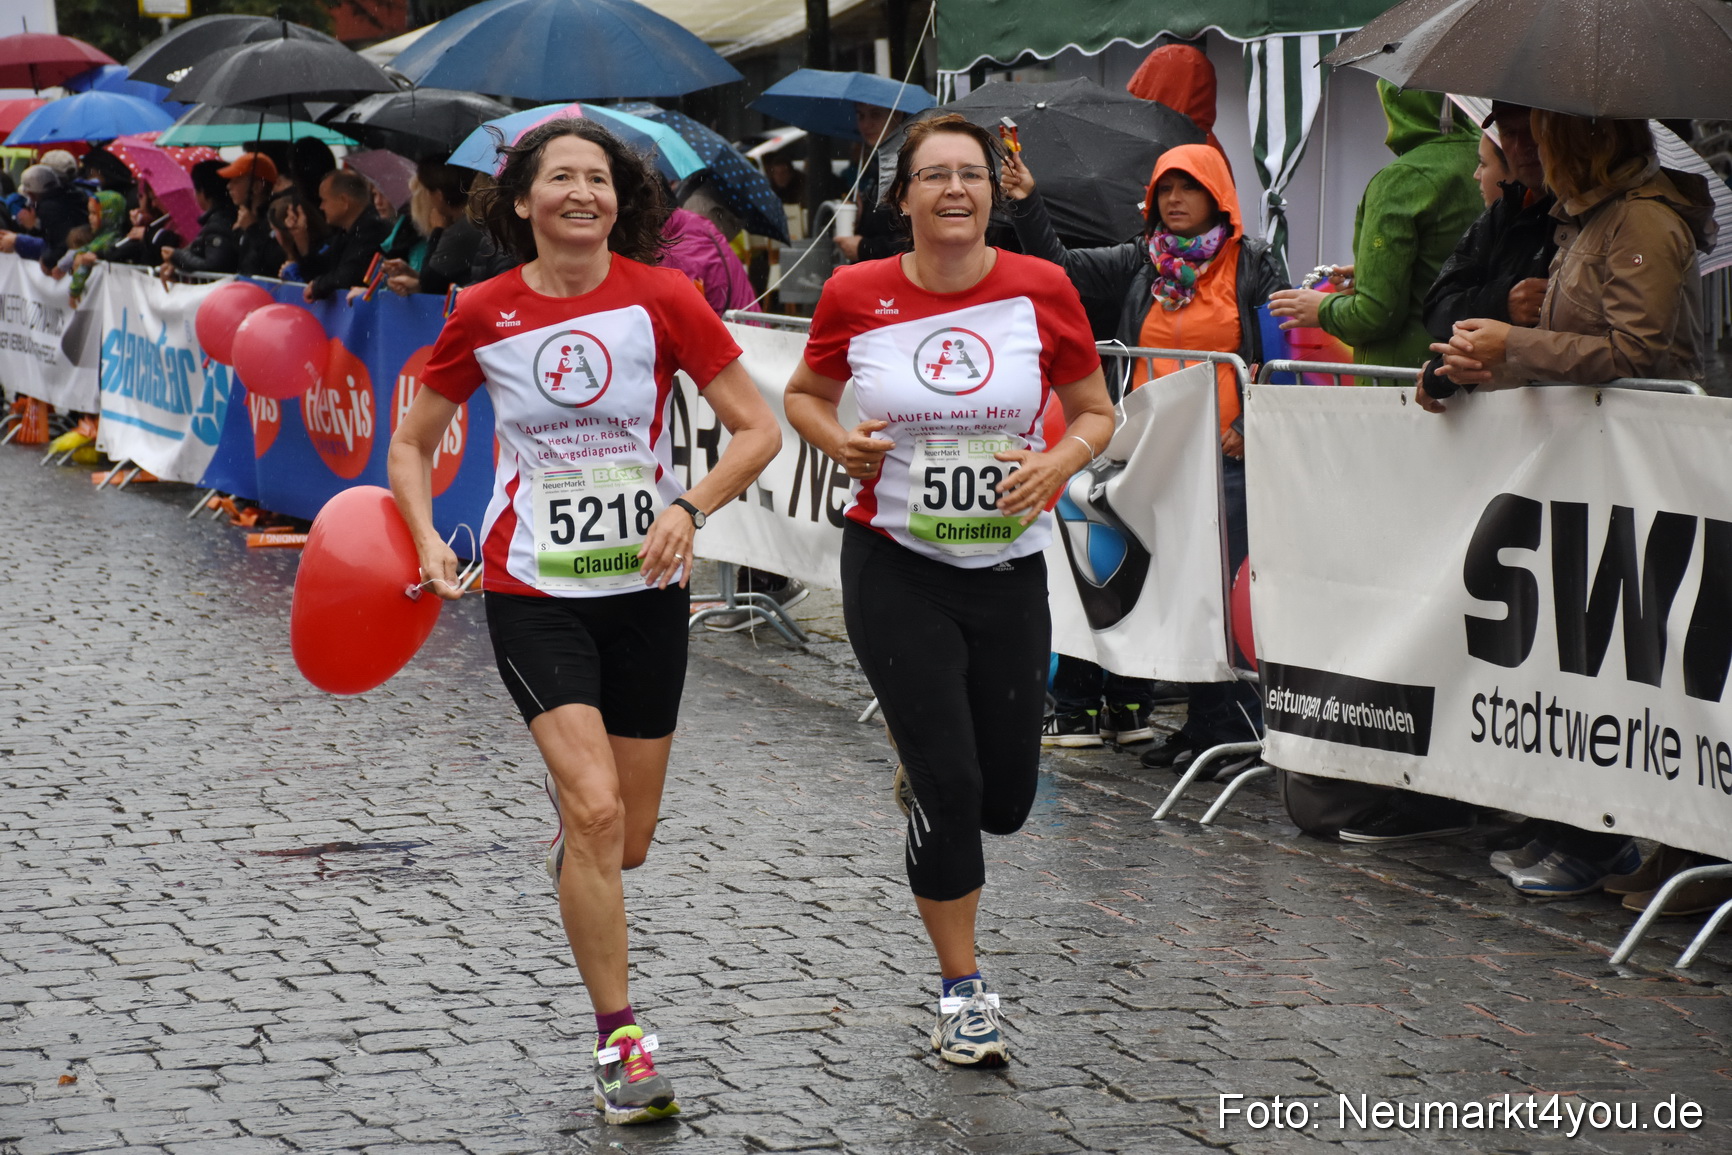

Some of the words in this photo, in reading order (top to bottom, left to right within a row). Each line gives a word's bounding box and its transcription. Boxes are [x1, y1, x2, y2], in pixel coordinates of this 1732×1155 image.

[305, 375, 372, 452] Hervis
[575, 417, 600, 427] MIT
[887, 411, 942, 423] LAUFEN
[951, 409, 978, 419] MIT
[986, 406, 1021, 419] HERZ
[548, 435, 573, 446] Heck
[583, 434, 598, 442] Dr.
[538, 442, 637, 461] Leiungsdiagnostik
[543, 480, 585, 490] NeuerMarkt
[923, 465, 1020, 512] 503
[549, 490, 654, 545] 5218
[936, 522, 1012, 540] Christina
[574, 552, 639, 574] Claudia
[1265, 685, 1321, 722] Leistungen,
[1322, 696, 1340, 722] die
[1342, 702, 1415, 734] verbinden
[1471, 685, 1682, 780] stadtwerke
